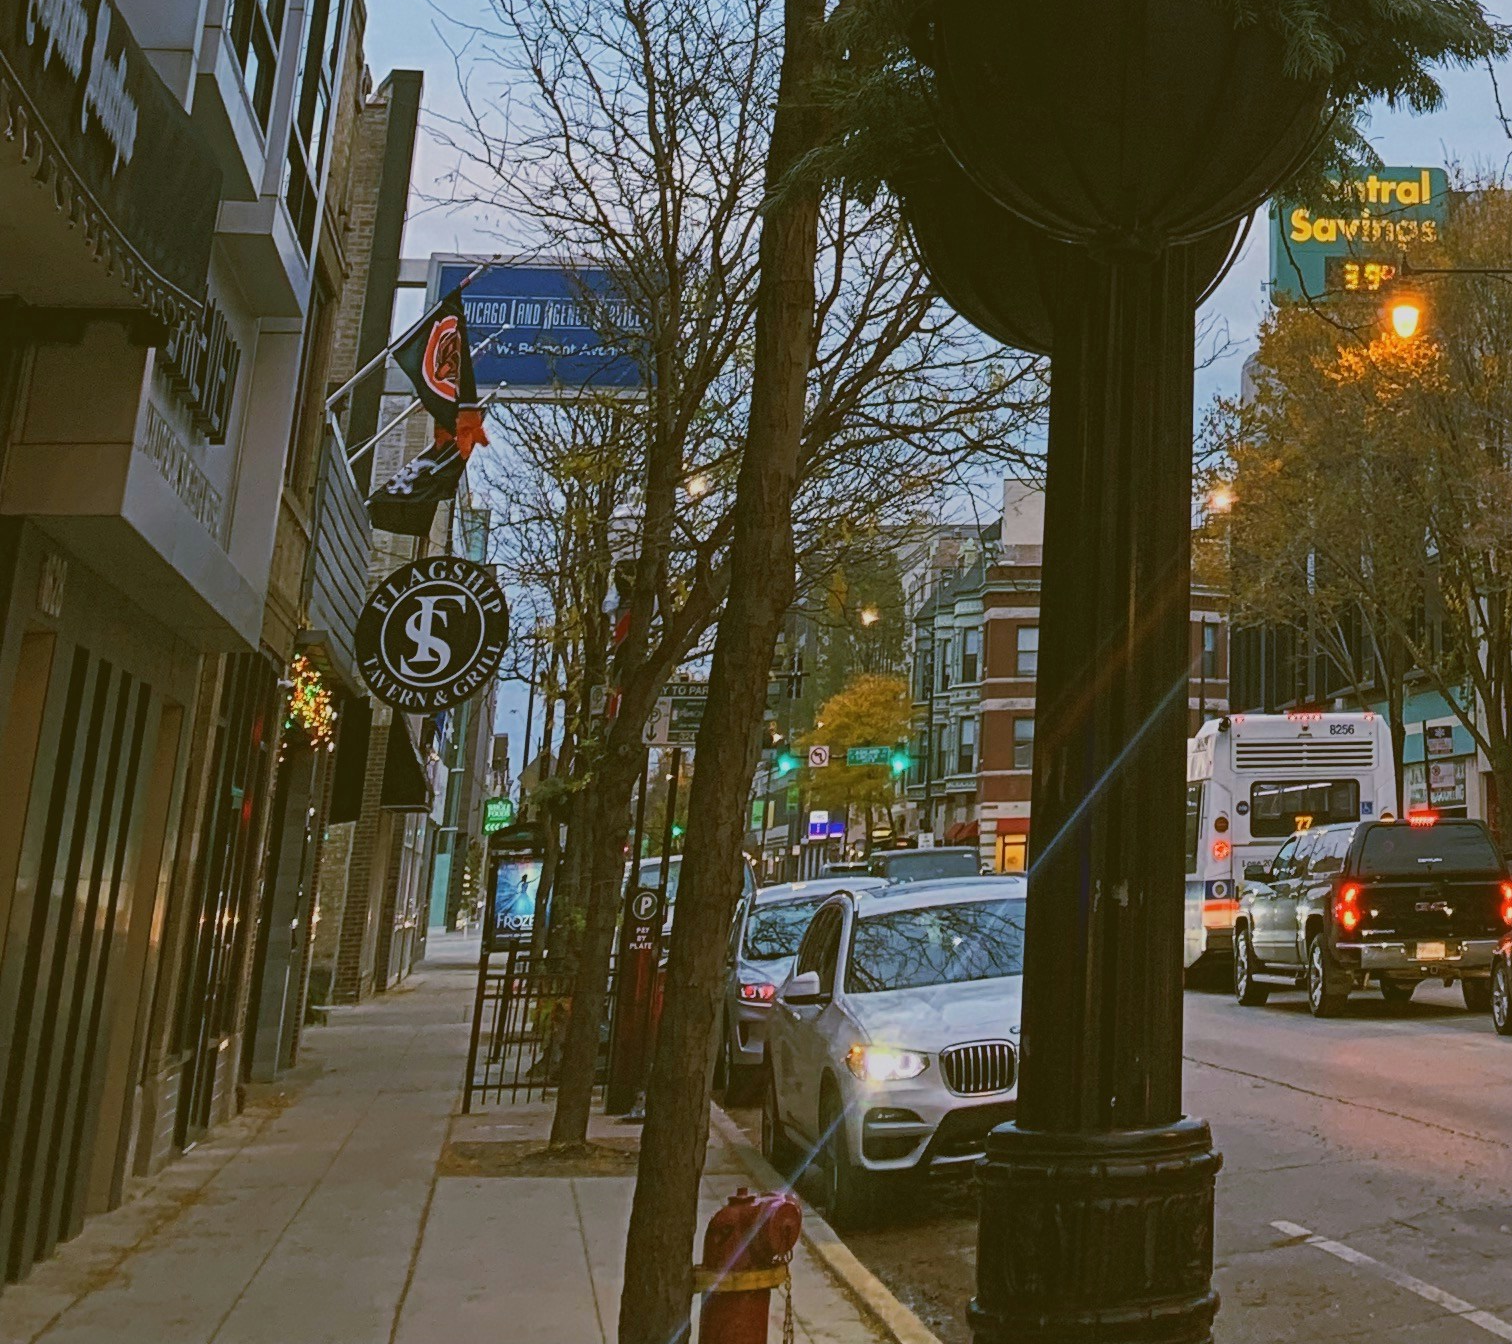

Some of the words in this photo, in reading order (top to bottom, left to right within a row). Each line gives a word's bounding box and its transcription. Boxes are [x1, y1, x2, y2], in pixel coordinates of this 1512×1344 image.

[372, 560, 502, 613] FLAGSHIP
[364, 653, 428, 707] TAVERN
[433, 690, 449, 707] &
[453, 641, 503, 697] GRILL
[1329, 724, 1355, 736] 8256
[1295, 816, 1313, 831] 77
[496, 913, 535, 932] FROZE
[636, 926, 650, 934] PAY
[629, 942, 653, 950] PLATE
